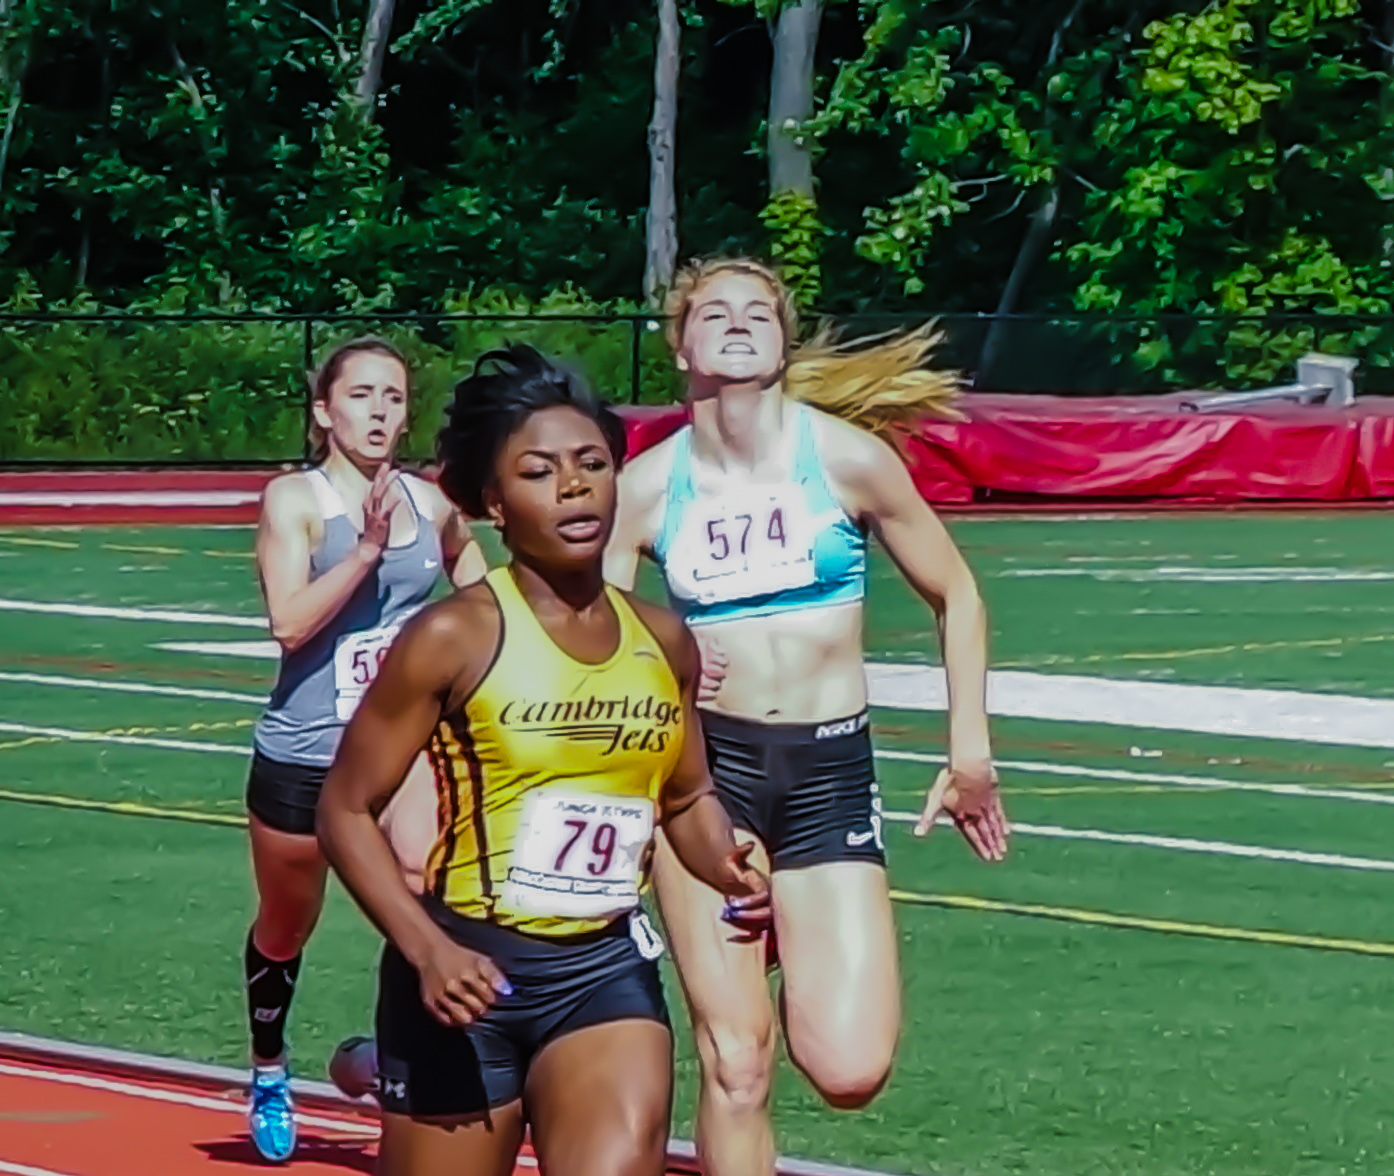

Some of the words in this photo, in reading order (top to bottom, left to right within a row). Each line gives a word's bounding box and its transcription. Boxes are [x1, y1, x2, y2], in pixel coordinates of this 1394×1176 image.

[707, 507, 785, 560] 574
[351, 647, 391, 684] 5
[498, 695, 682, 727] Cambridge
[598, 723, 670, 756] Jets
[553, 819, 617, 876] 79
